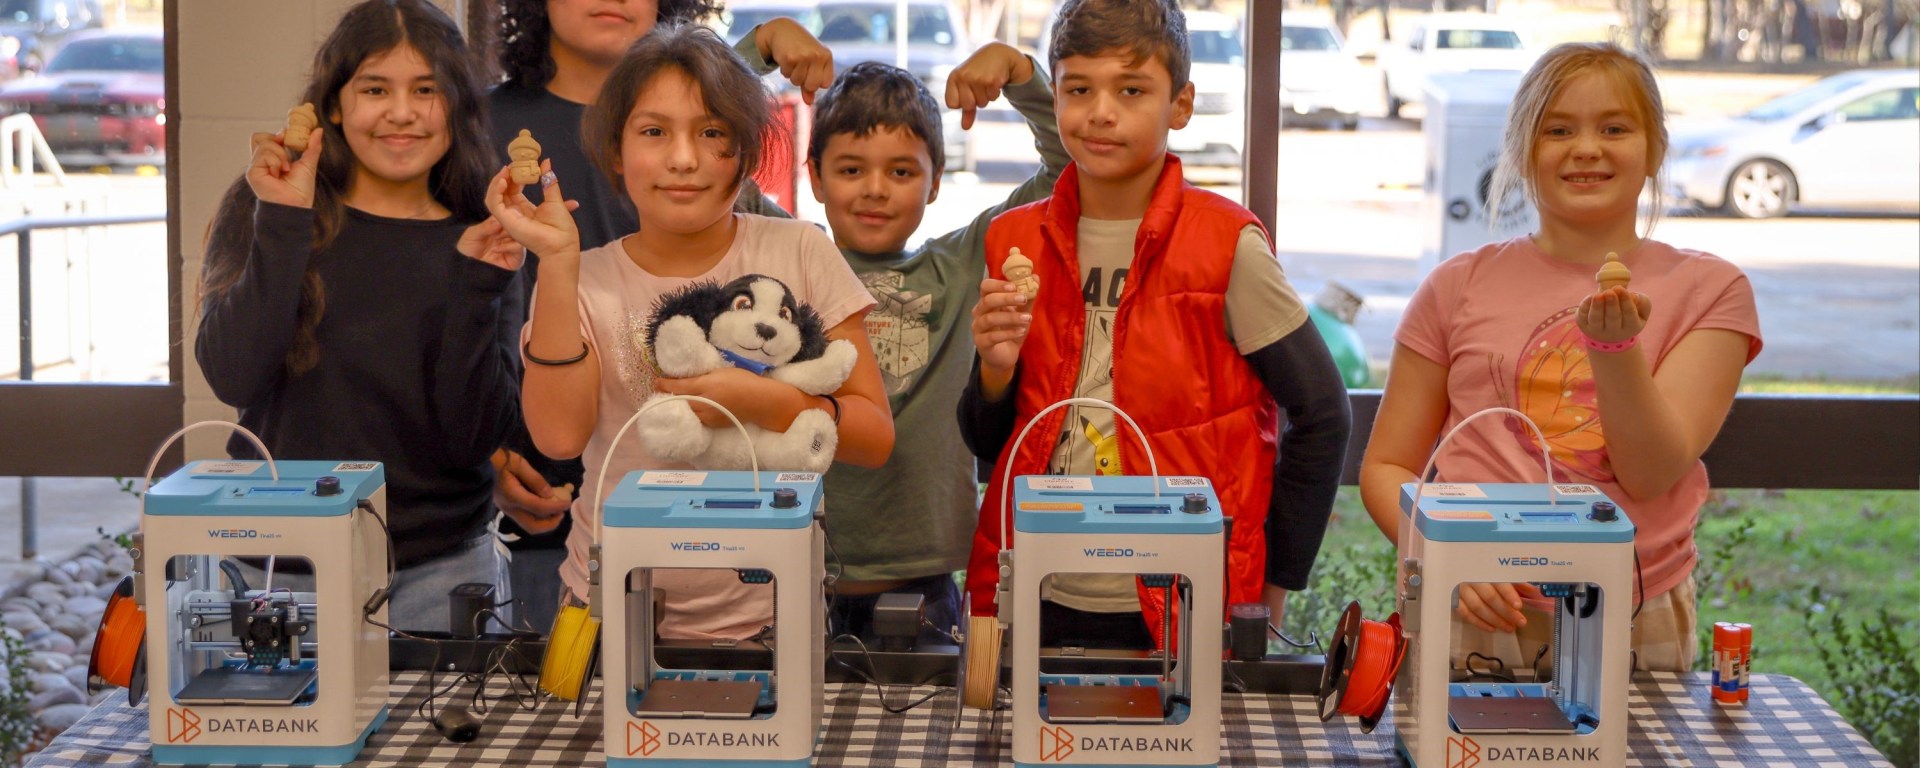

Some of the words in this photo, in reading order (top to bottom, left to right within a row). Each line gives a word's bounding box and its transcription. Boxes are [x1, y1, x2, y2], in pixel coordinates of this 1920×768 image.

[208, 529, 257, 538] WEEDO
[671, 541, 720, 551] WEEDO
[1083, 548, 1134, 557] WEEDO
[1498, 557, 1549, 566] WEEDO
[208, 718, 319, 733] DATABANK
[668, 731, 780, 747] DATABANK
[1081, 737, 1193, 752] DATABANK
[1487, 746, 1600, 761] DATABANK
